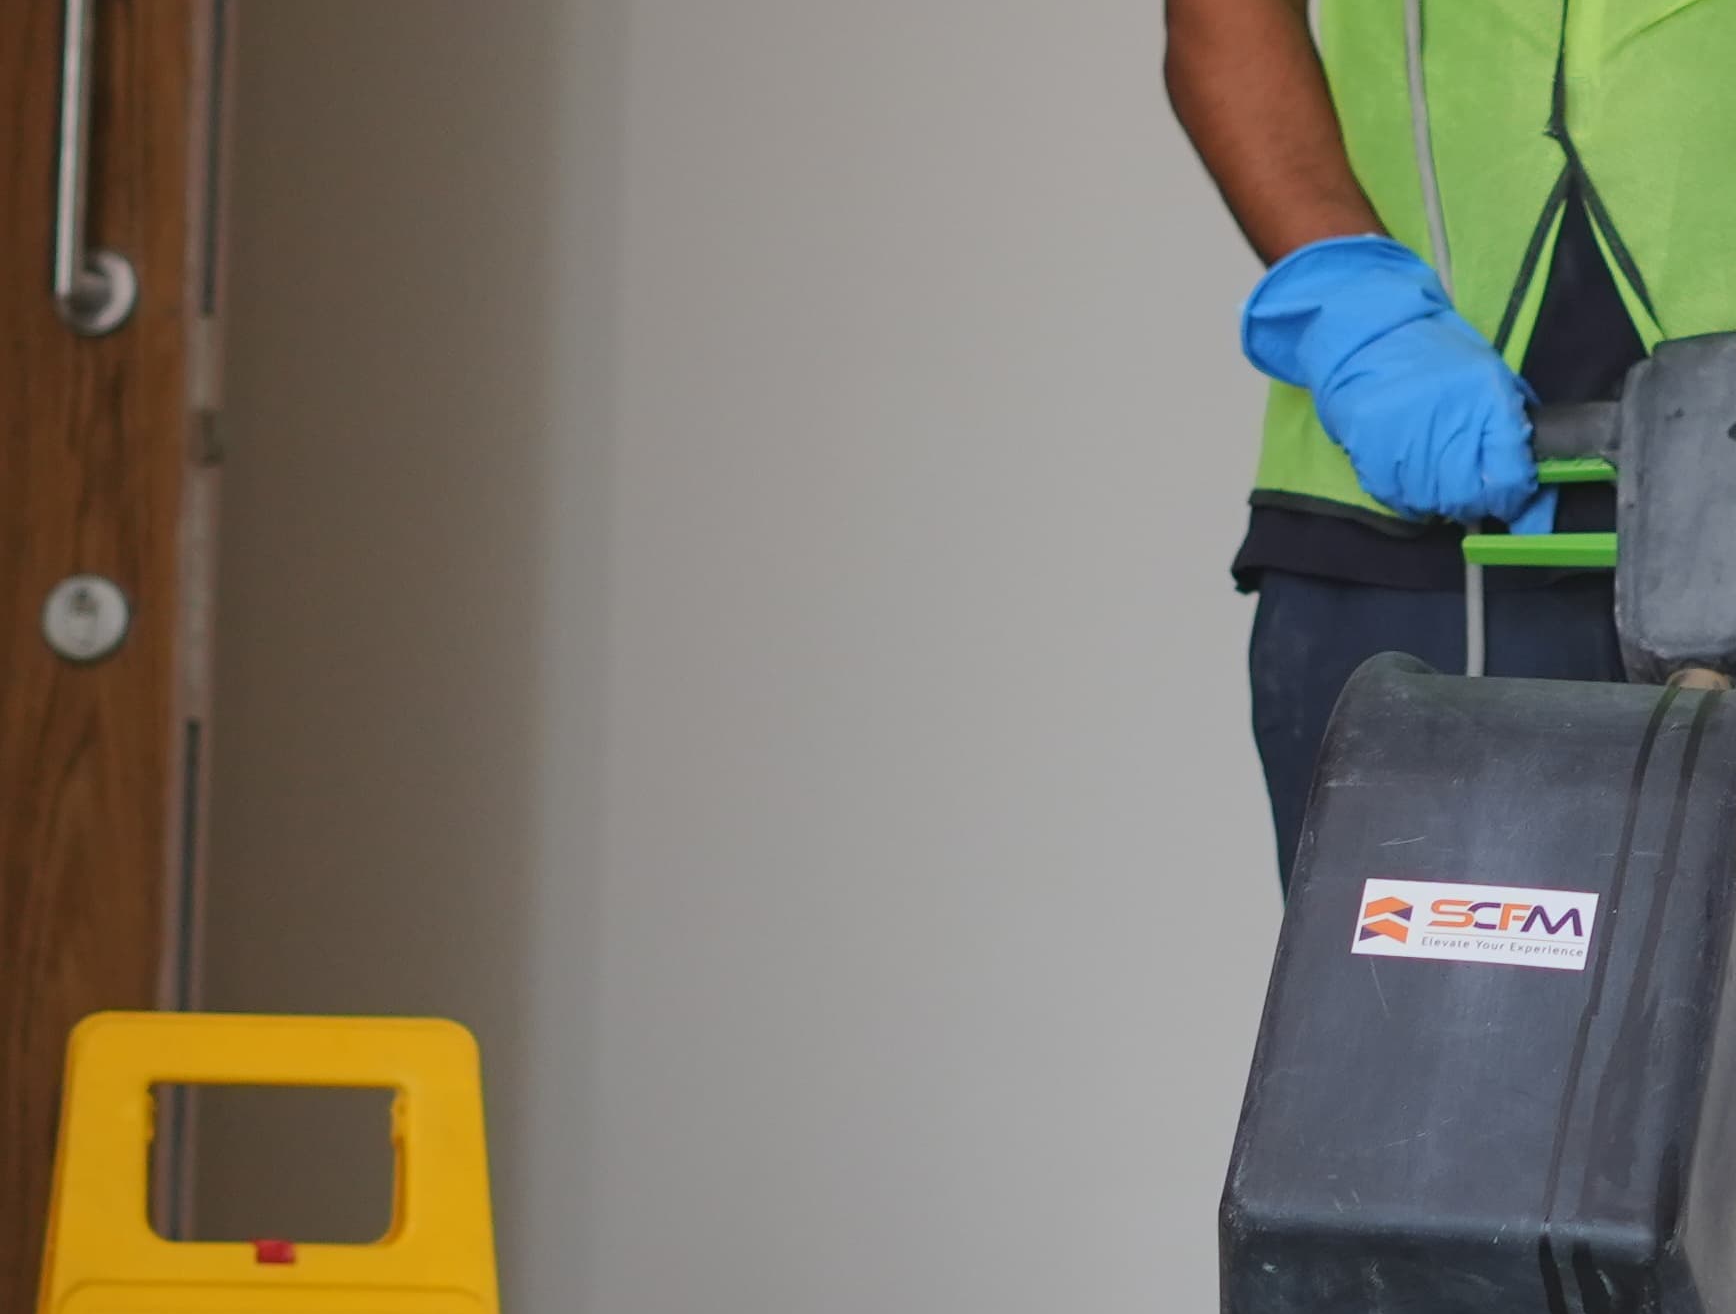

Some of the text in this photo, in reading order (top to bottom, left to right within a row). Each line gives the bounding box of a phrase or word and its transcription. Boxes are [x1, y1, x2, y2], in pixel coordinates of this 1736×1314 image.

[1427, 899, 1583, 937] SCFM
[1421, 936, 1584, 957] Elevate Your Experience
